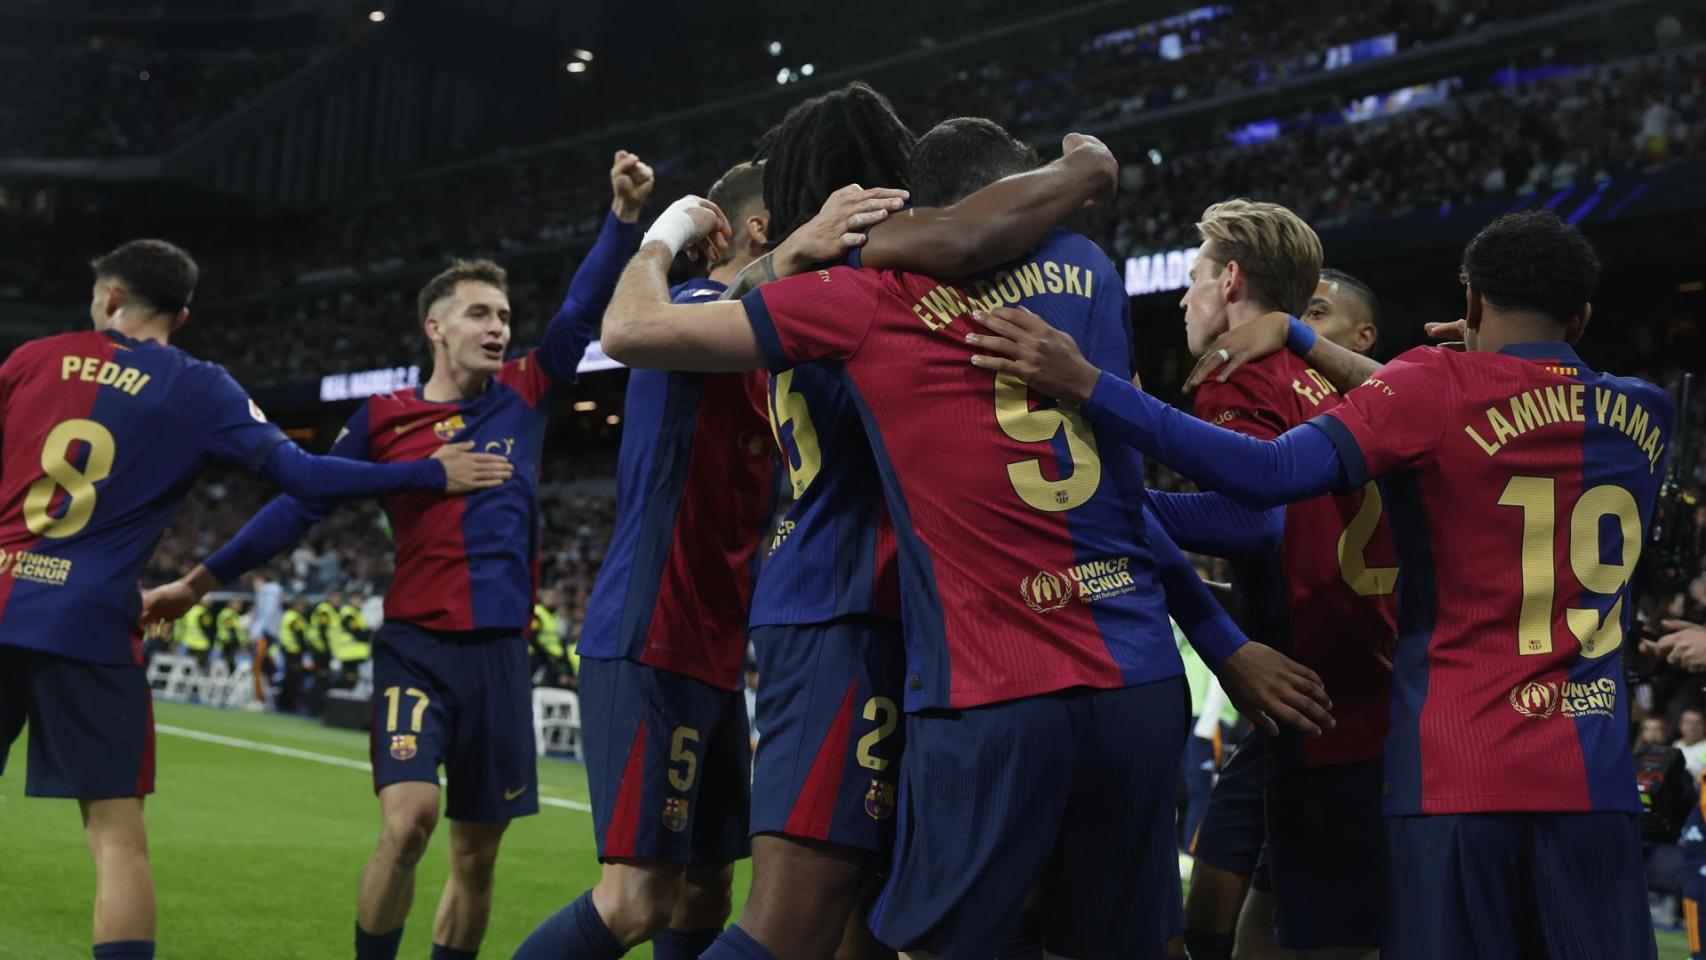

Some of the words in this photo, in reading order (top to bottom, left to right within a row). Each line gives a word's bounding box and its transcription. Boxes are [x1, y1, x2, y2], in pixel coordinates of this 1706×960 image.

[1125, 247, 1200, 296] MADR
[61, 354, 152, 397] PEDRI
[1464, 384, 1586, 457] LAMINE
[23, 418, 116, 539] 8
[11, 563, 68, 581] ACNUR
[16, 551, 72, 571] UNHCR
[1067, 557, 1129, 581] UNHCR
[1497, 475, 1642, 660] 19
[1079, 571, 1134, 597] ACNUR
[383, 686, 430, 733] 17
[1561, 678, 1616, 697] UNHCR
[668, 726, 700, 792] 5
